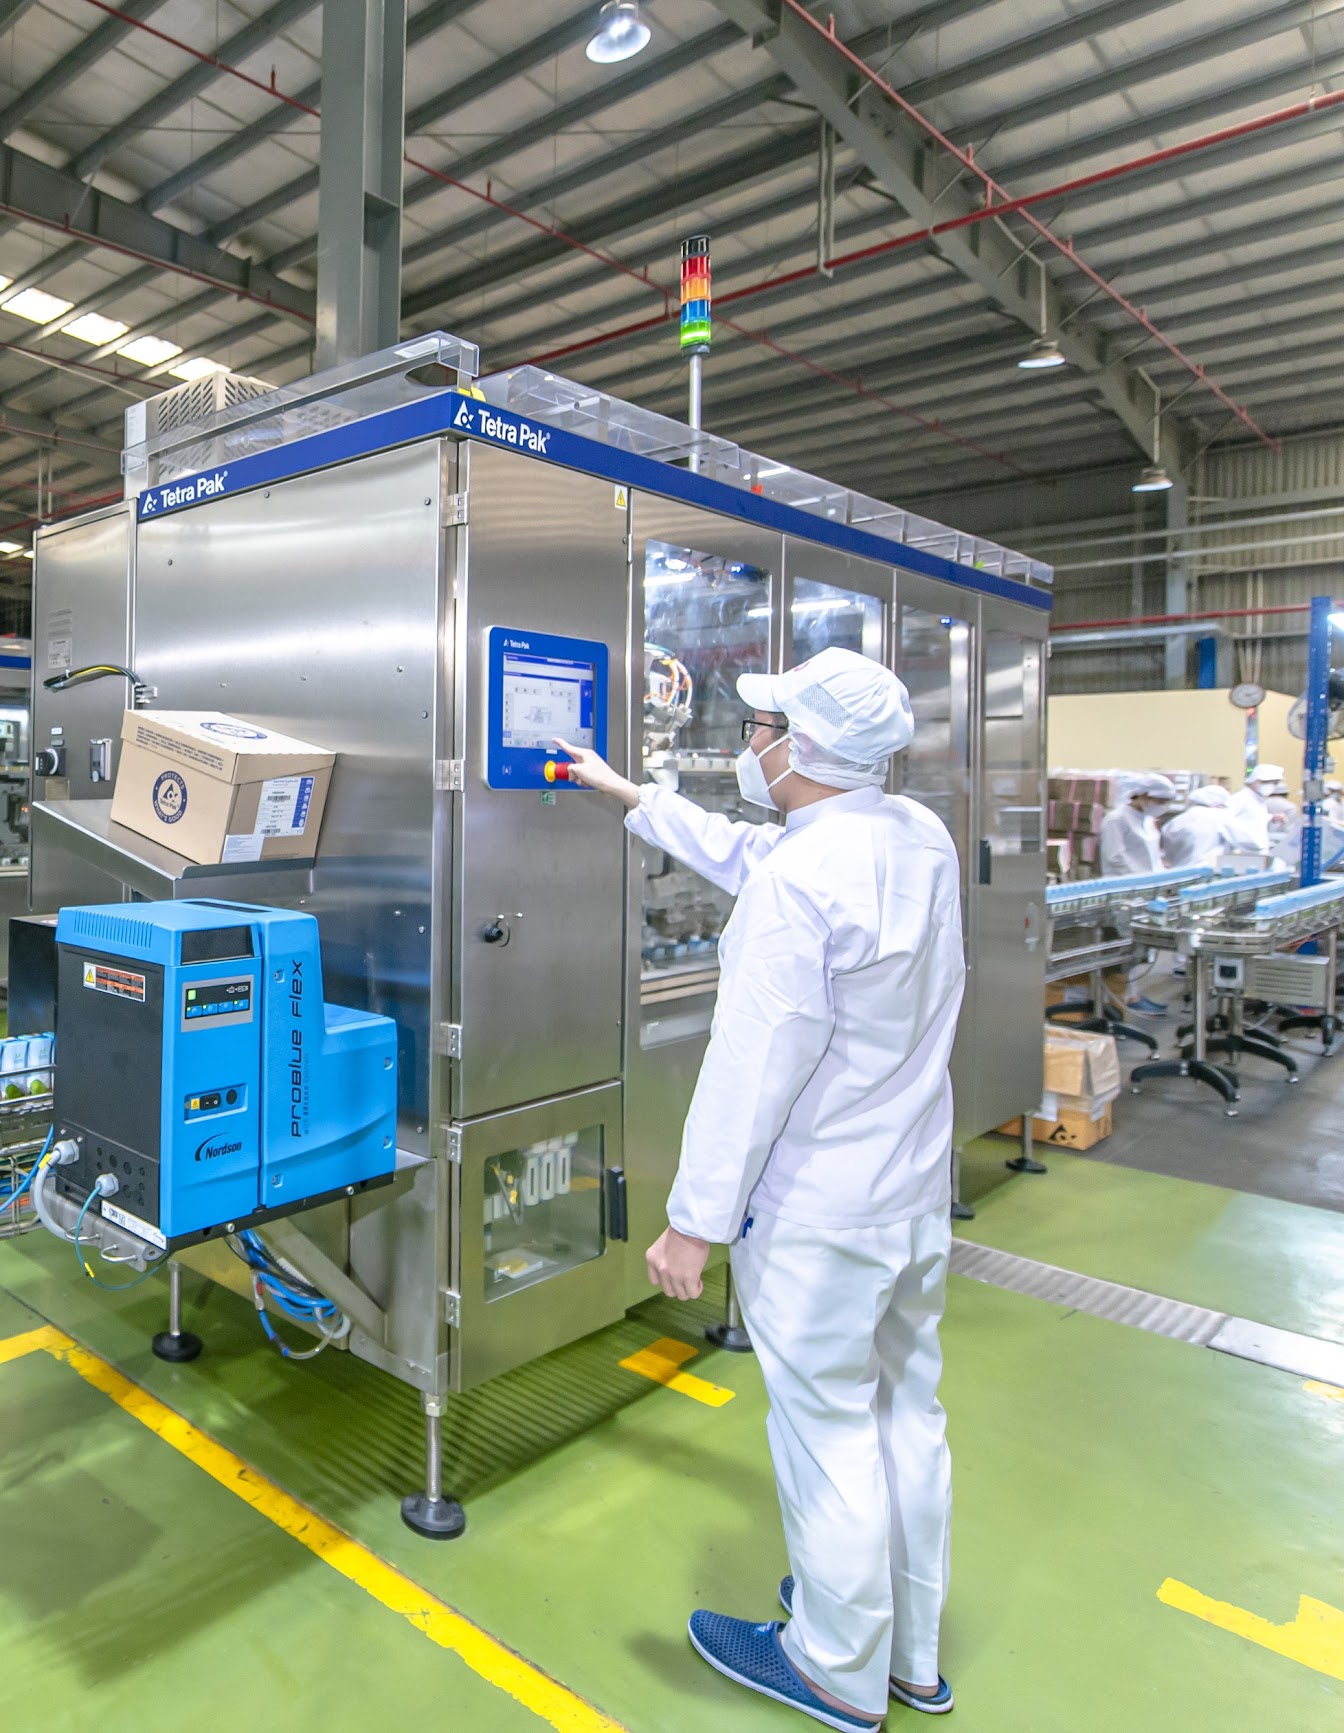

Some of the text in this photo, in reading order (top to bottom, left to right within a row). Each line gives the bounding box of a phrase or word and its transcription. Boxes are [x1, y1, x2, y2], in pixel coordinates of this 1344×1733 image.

[478, 408, 517, 444] Tetra
[160, 486, 195, 508] Tetra
[160, 772, 185, 790] PROTECTS
[154, 799, 183, 823] WHAT'S GOOD
[205, 1141, 242, 1160] Nordson
